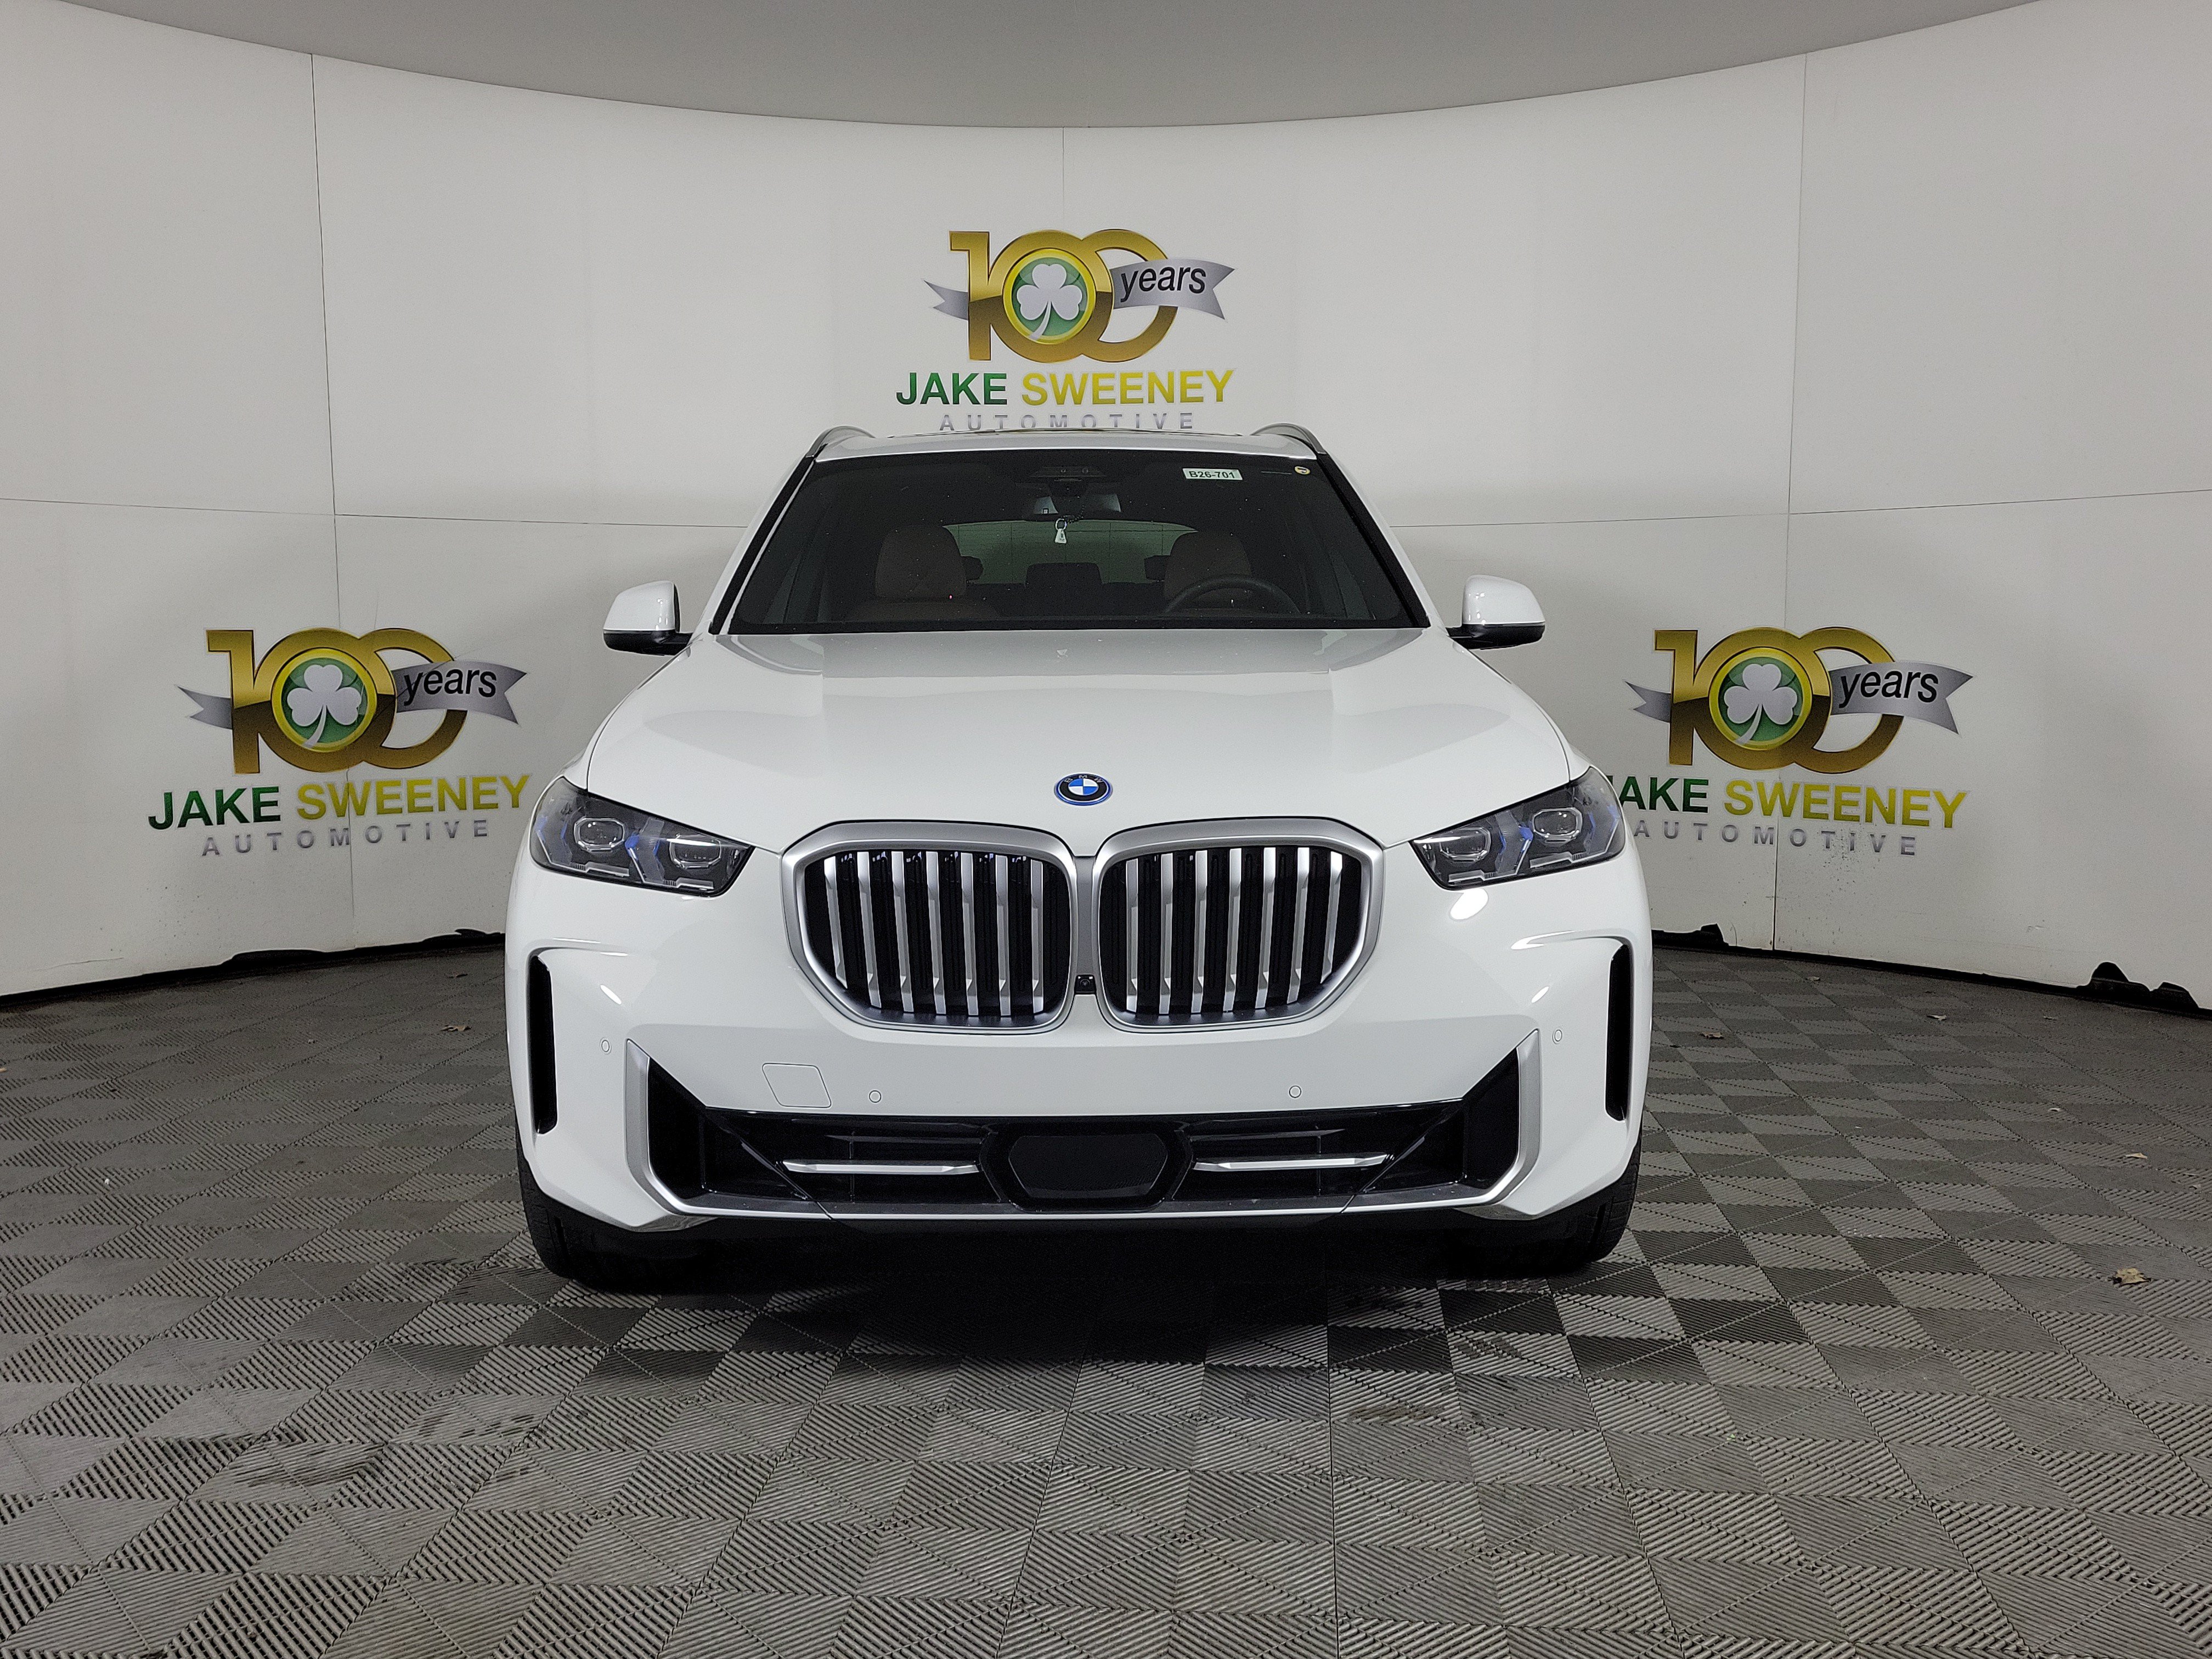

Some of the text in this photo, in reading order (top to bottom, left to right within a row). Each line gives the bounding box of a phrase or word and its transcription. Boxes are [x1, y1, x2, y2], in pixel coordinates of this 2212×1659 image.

[949, 229, 1206, 363] 100 years
[896, 370, 1234, 405] JAKE SWEENEY
[939, 412, 1193, 431] AUTOMOTIVE
[1188, 470, 1235, 479] B26-701
[206, 627, 496, 774] 100 years
[1654, 627, 1939, 774] 100 years
[1064, 774, 1104, 783] BMW
[148, 775, 531, 830] JAKE SWEENEY
[1606, 775, 1967, 829] AKE SWEENEY
[202, 819, 488, 856] AUTOMOTIVE
[1634, 820, 1915, 856] AUTOMOTIVE
